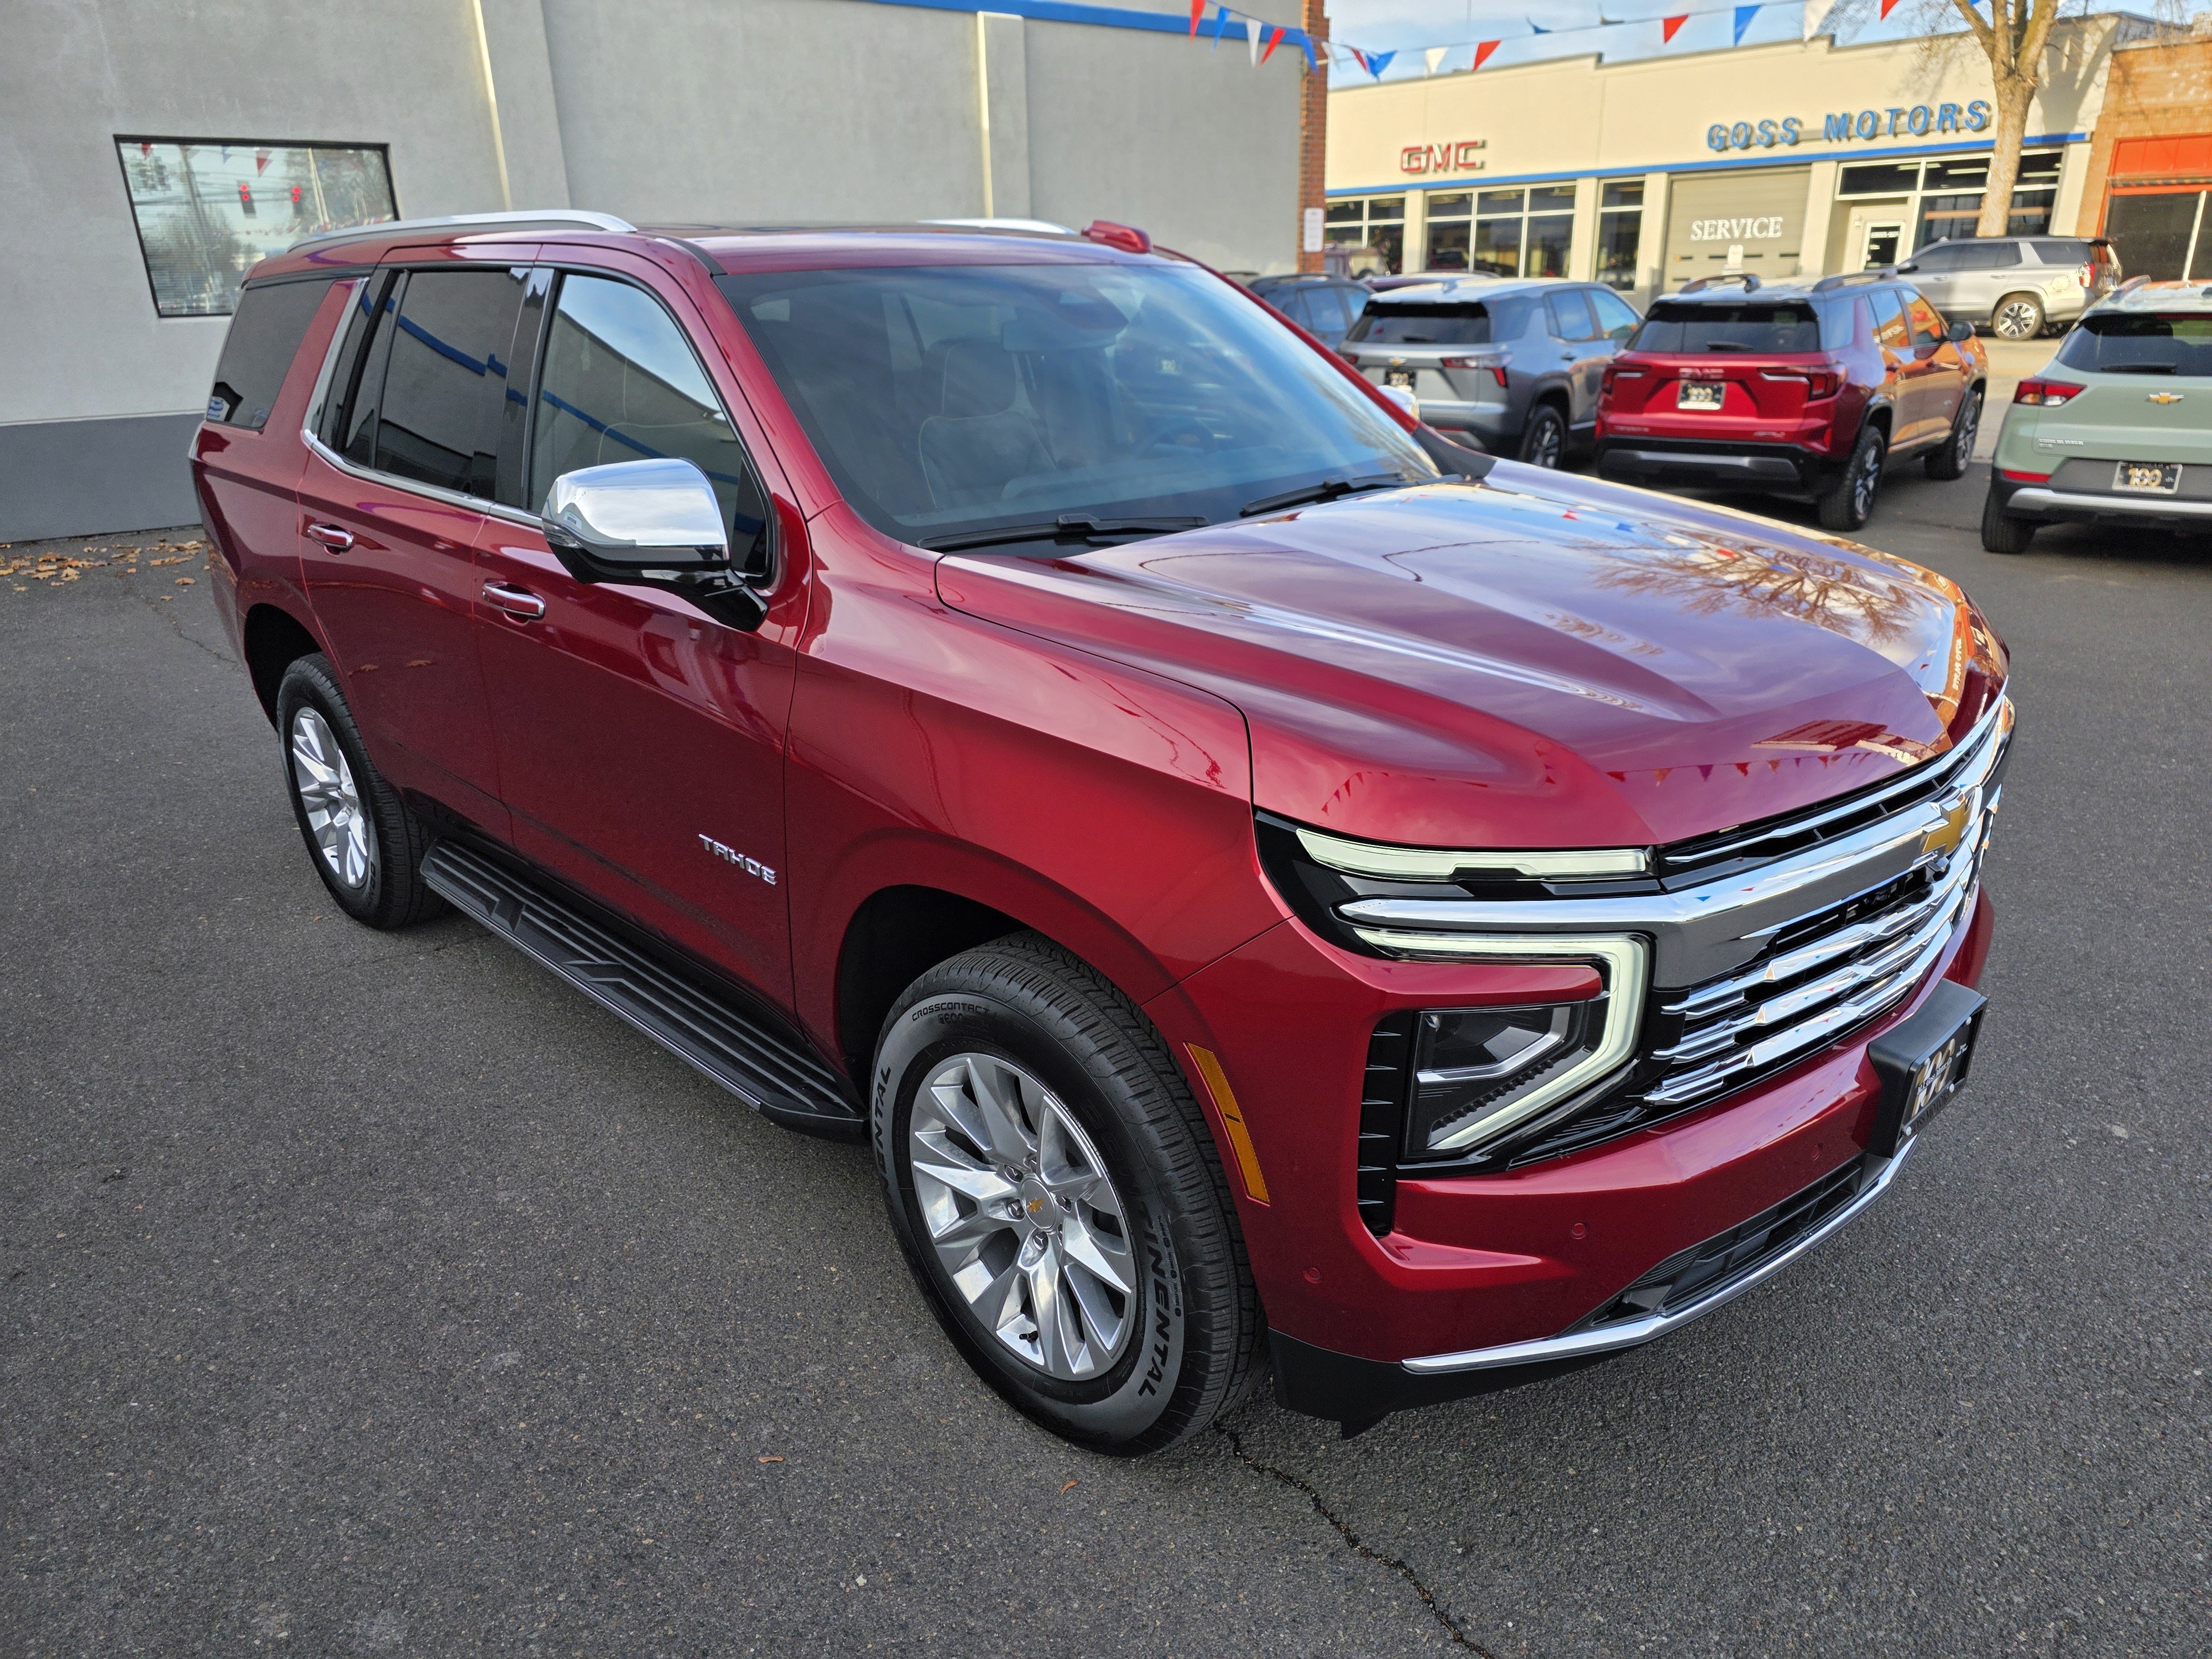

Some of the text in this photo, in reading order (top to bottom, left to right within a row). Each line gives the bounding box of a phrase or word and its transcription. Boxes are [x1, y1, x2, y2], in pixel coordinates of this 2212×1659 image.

[1707, 100, 1987, 150] GOSS MOTORS
[1401, 139, 1483, 172] GMC
[1691, 216, 1783, 241] SERVICE
[2128, 467, 2162, 487] 100
[698, 833, 778, 885] TAHOE
[912, 1002, 990, 1022] CROSSCONTACT
